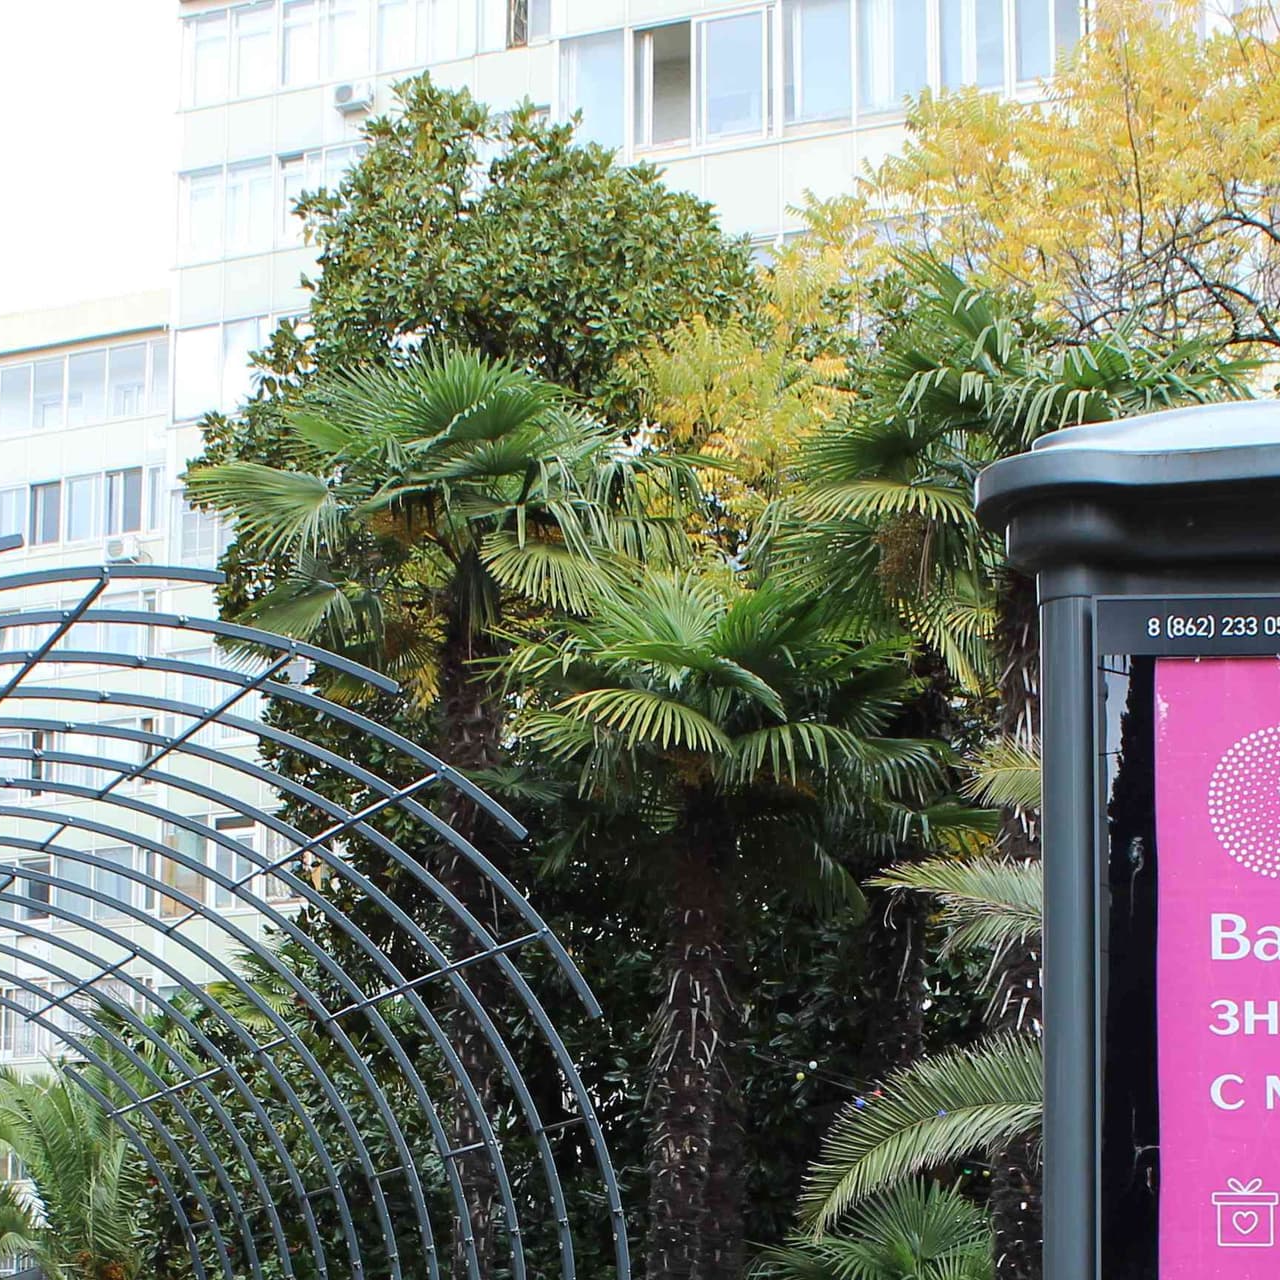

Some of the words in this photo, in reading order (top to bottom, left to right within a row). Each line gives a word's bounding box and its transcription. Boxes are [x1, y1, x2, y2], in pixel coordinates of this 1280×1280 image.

[1148, 617, 1161, 637] 8
[1167, 615, 1215, 639] (862)
[1221, 616, 1258, 636] 233
[1210, 1073, 1245, 1110] с
